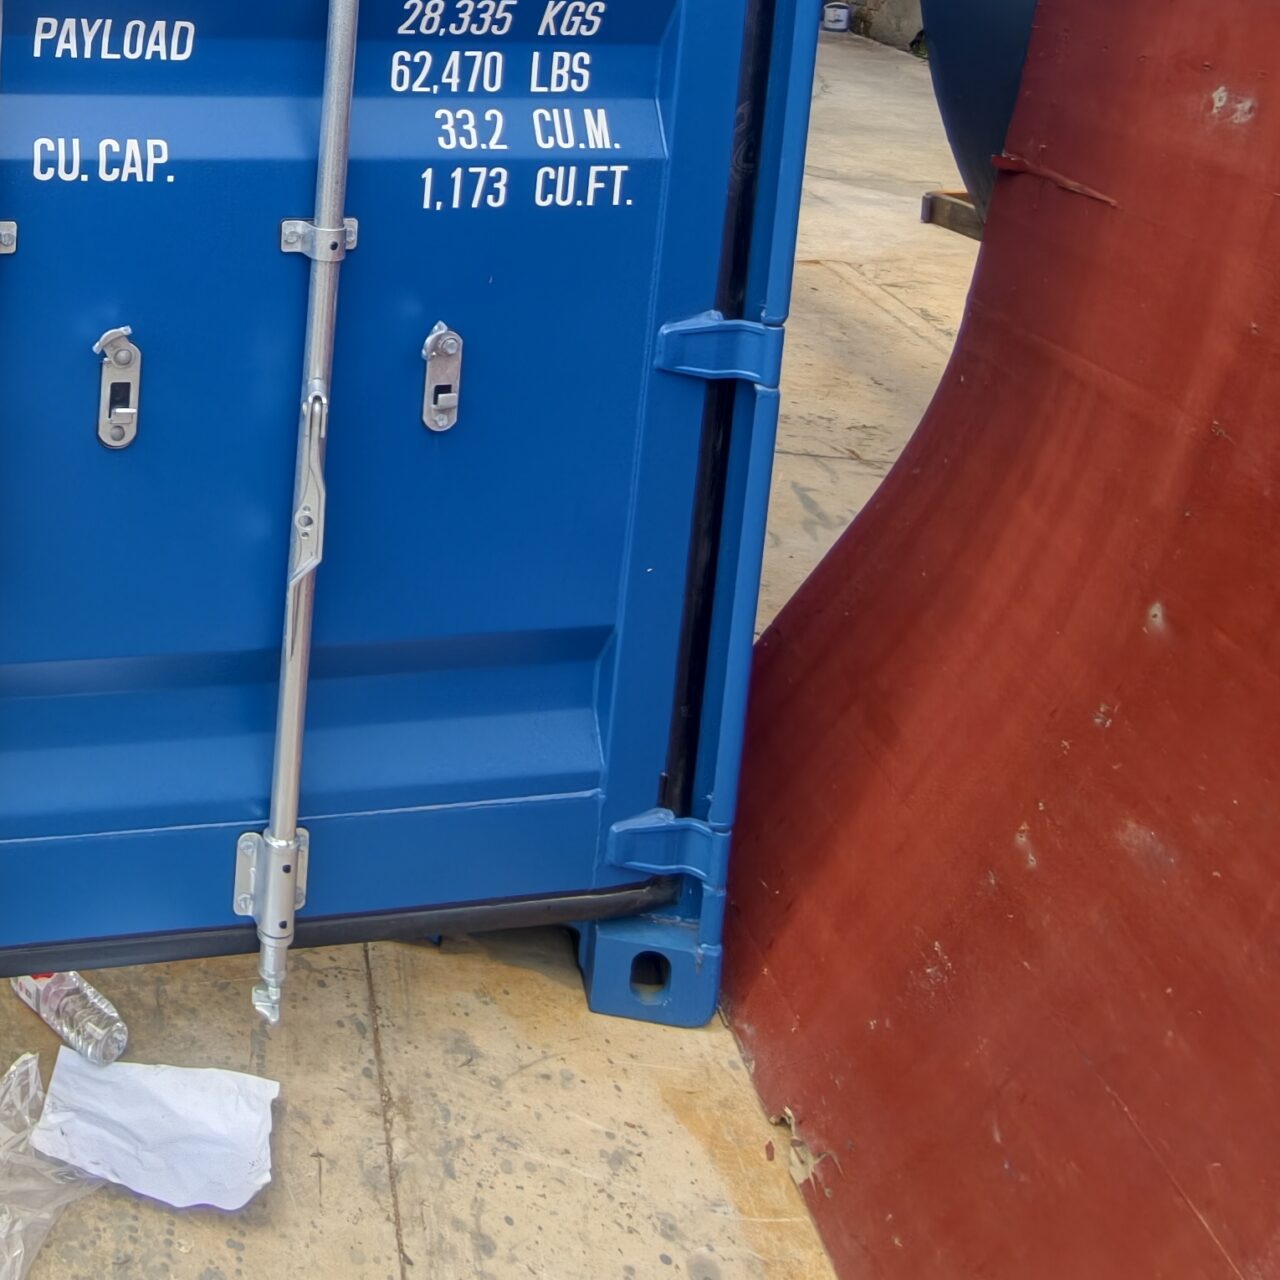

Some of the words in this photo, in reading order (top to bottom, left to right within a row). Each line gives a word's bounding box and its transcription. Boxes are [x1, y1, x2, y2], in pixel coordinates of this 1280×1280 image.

[33, 16, 196, 61] PAYLOAD
[537, 0, 606, 36] KGS
[390, 50, 504, 94] 62,470
[530, 51, 591, 93] LBS
[434, 107, 509, 150] 33.2
[532, 107, 621, 149] CU.M.
[421, 166, 508, 211] 1,173
[535, 165, 633, 207] CU.FT.
